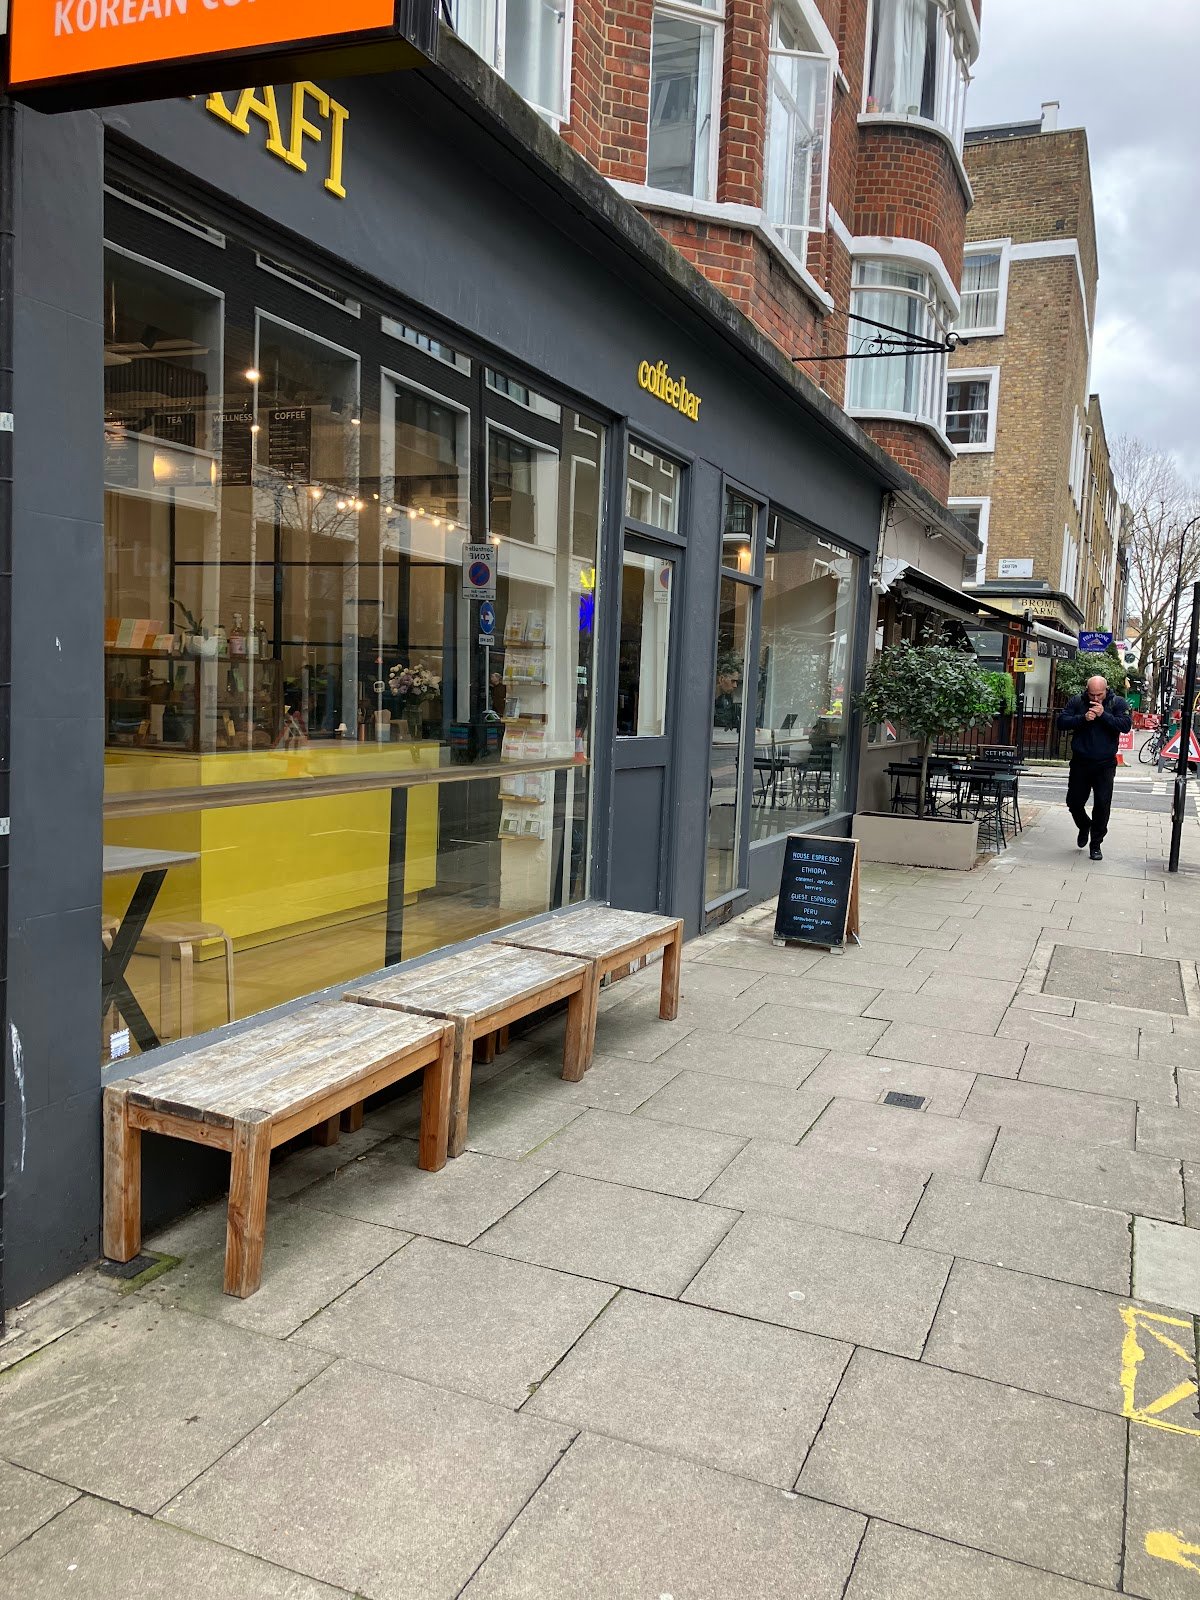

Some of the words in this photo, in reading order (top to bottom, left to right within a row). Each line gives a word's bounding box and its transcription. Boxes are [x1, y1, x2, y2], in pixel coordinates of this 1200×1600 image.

[190, 80, 350, 199] AFI
[212, 413, 253, 424] WELLNESS
[274, 410, 306, 420] COFFEE
[166, 416, 183, 425] TEA
[1032, 607, 1058, 616] ARMS
[1082, 633, 1094, 642] FISH
[1094, 633, 1109, 643] BONE
[801, 866, 827, 875] ETHIOPIA
[790, 892, 809, 901] GUEST
[803, 907, 818, 916] PERU
